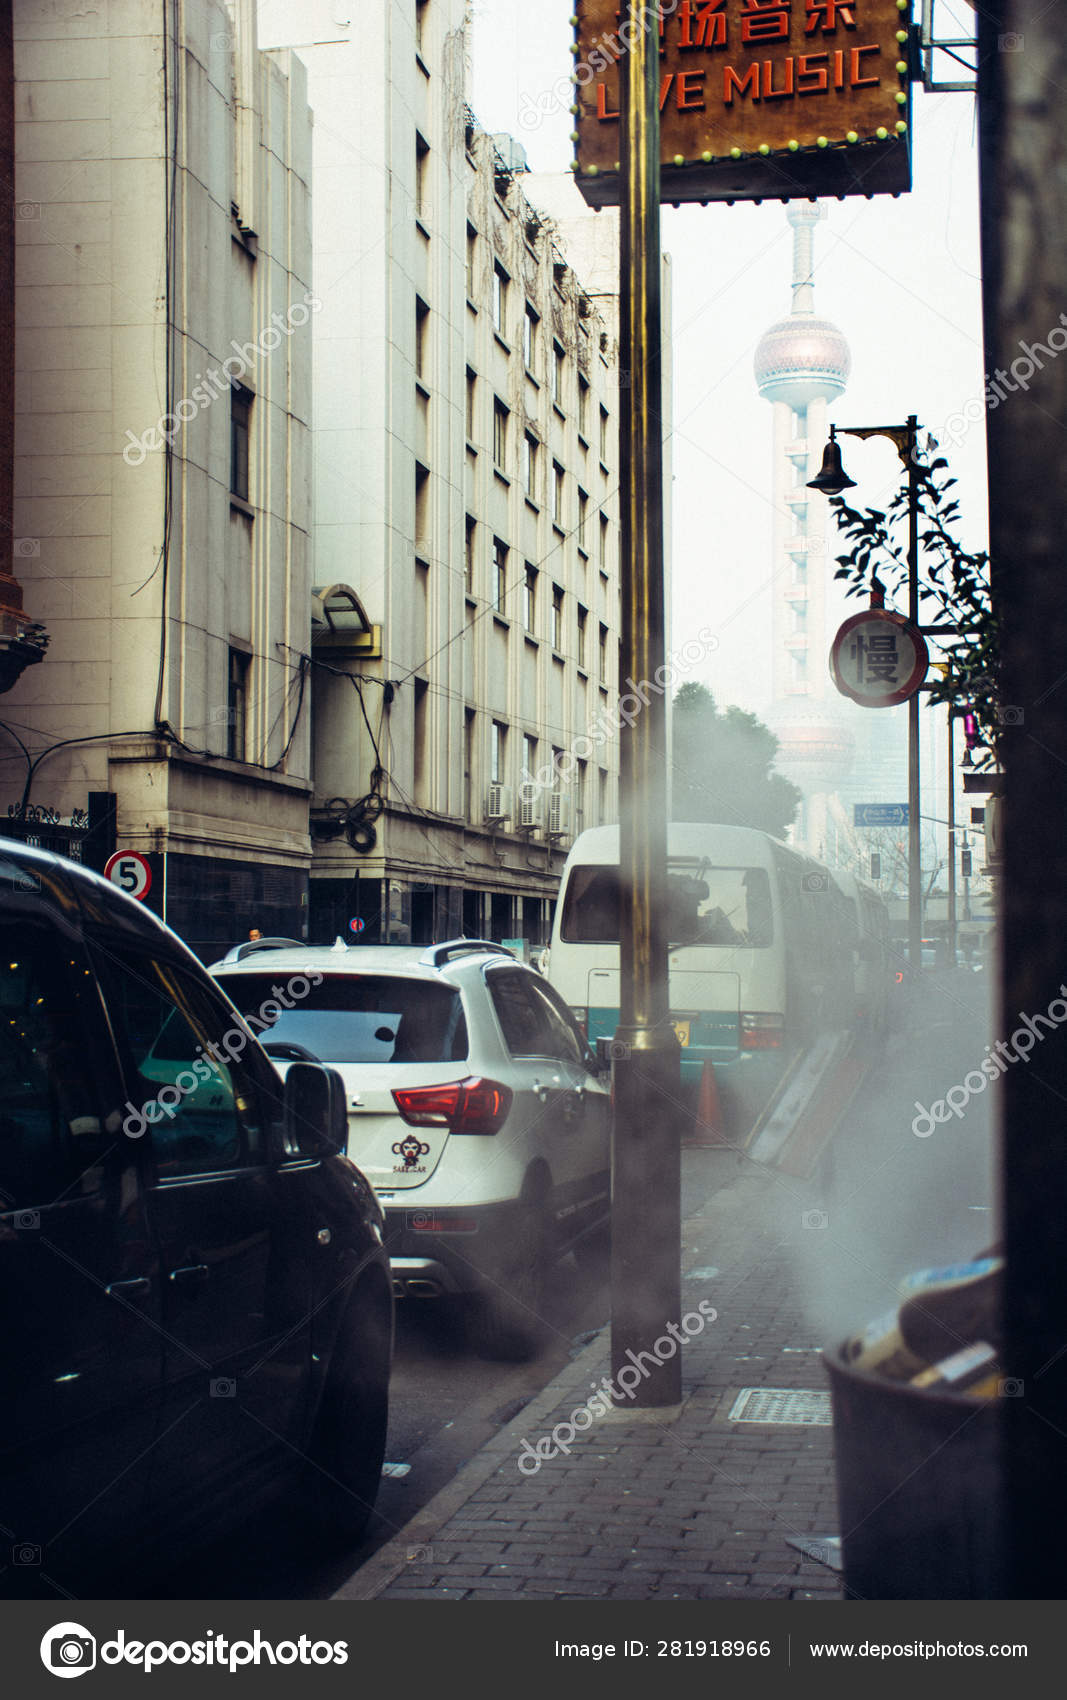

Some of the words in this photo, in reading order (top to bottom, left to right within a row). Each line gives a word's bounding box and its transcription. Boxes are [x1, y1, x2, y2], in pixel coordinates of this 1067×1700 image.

[615, 0, 856, 49] 场音乐
[724, 44, 880, 104] MUSIC
[851, 634, 898, 684] 慢
[120, 862, 138, 893] 5
